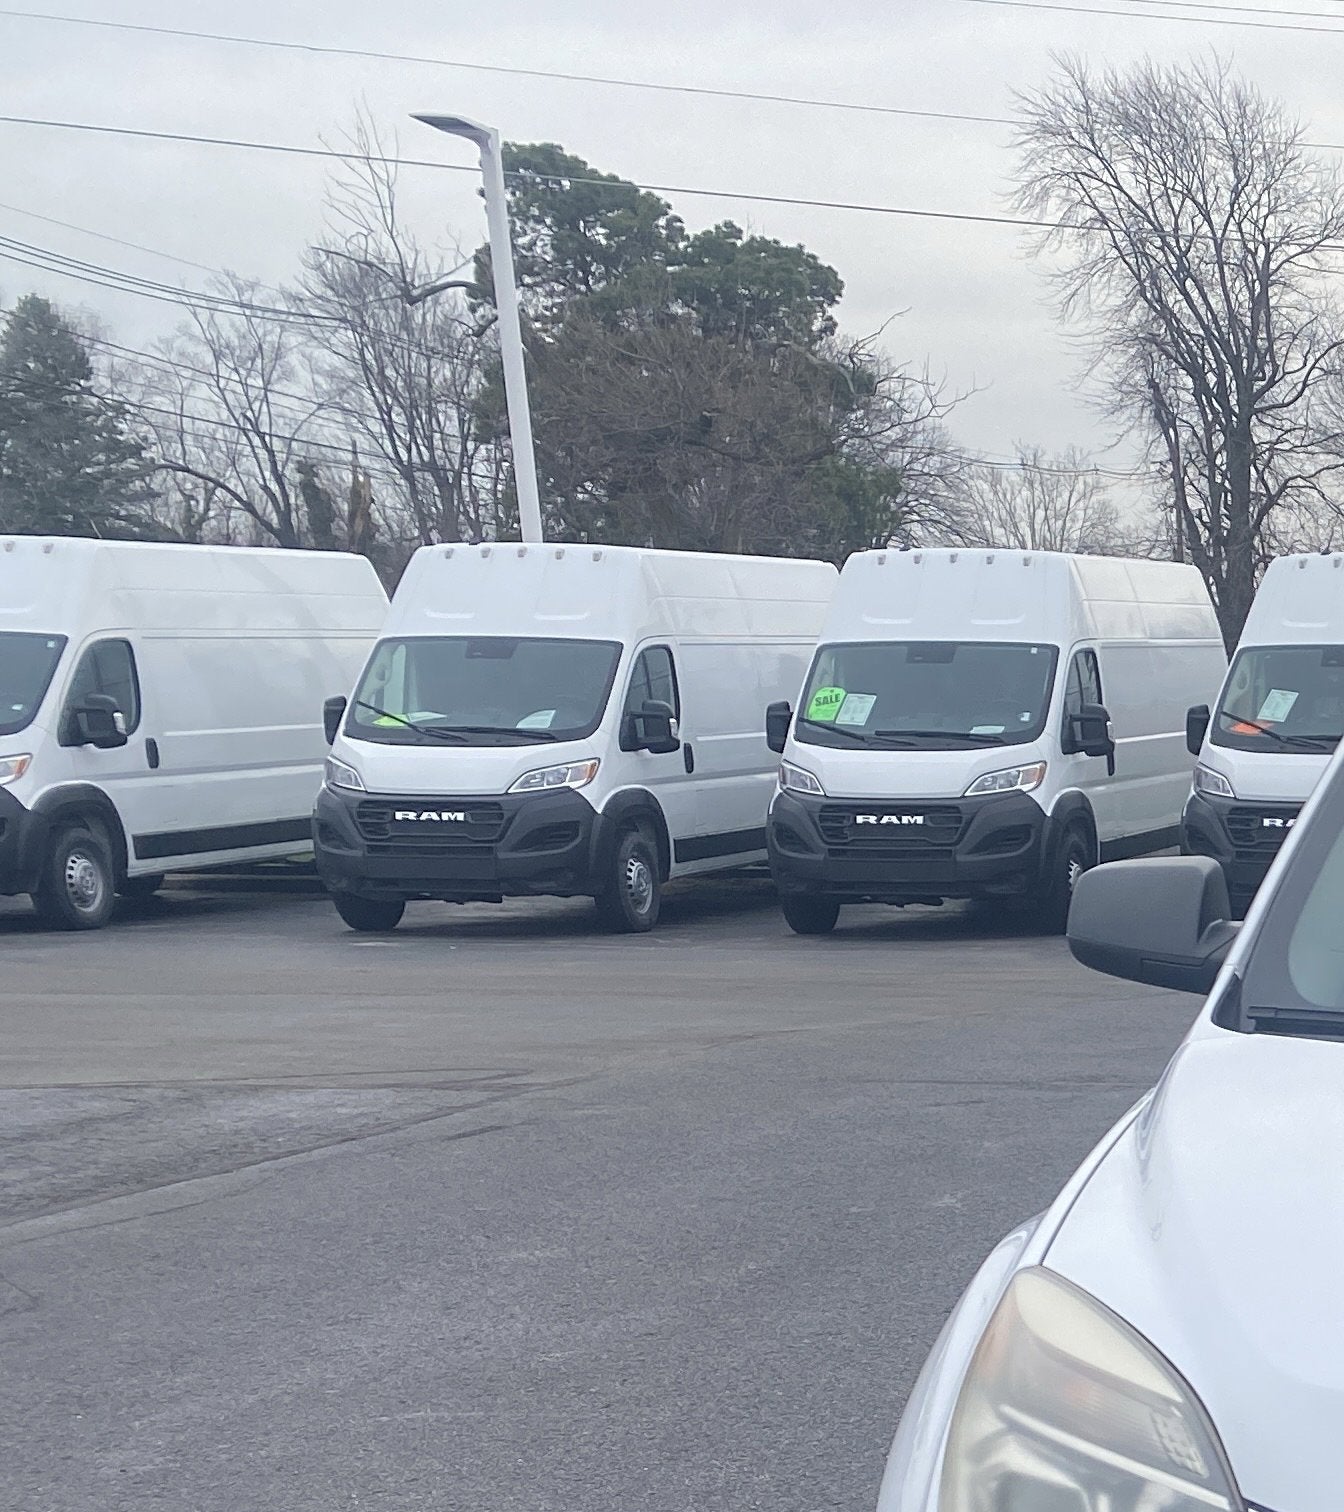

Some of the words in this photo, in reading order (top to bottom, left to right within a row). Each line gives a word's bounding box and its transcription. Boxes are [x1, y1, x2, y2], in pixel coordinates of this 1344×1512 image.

[815, 693, 841, 706] SALE
[395, 811, 465, 821] RAM
[855, 815, 924, 824] RAM
